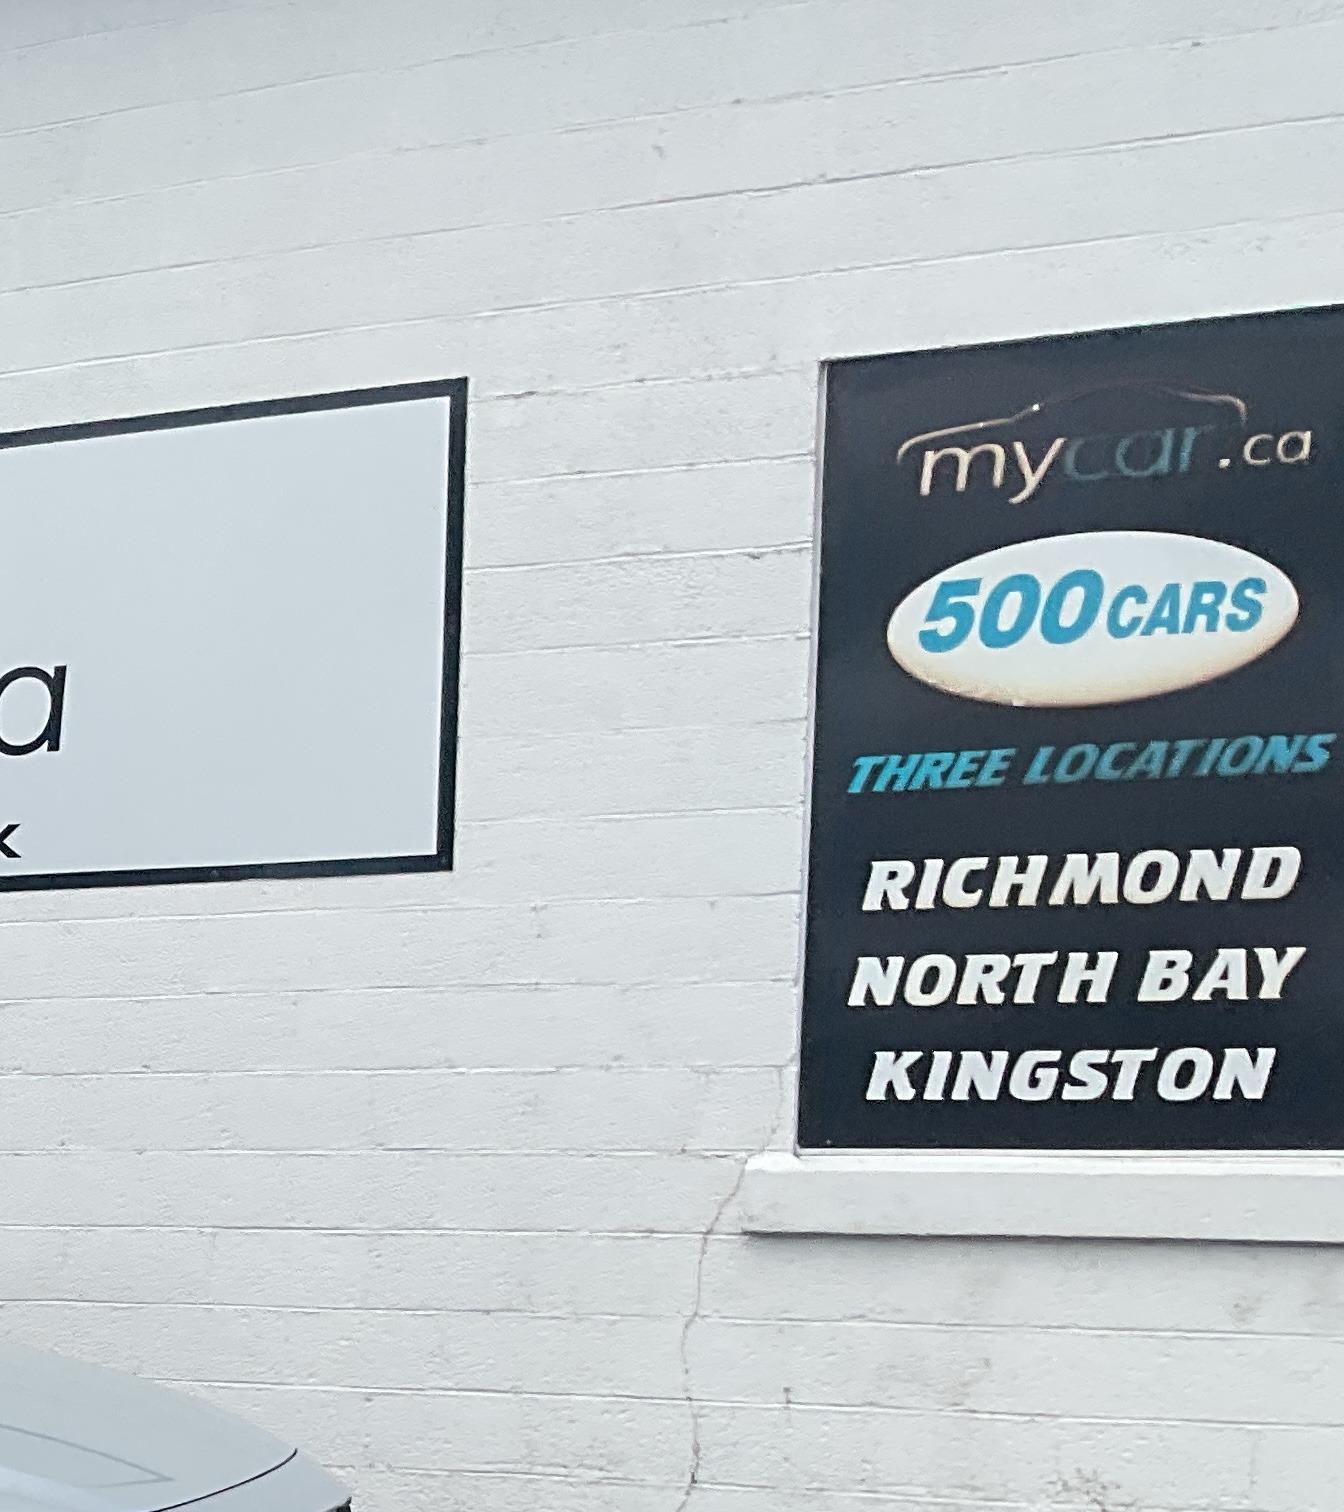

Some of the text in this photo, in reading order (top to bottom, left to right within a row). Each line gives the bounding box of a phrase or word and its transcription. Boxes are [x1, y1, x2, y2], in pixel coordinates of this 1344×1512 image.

[918, 569, 1267, 653] 500 CARS
[847, 733, 1337, 793] THREE LOCATIONS
[862, 847, 1301, 911] RICHMOND
[848, 947, 1306, 1006] NORTH BAY
[866, 1047, 1276, 1101] KINGSTON
